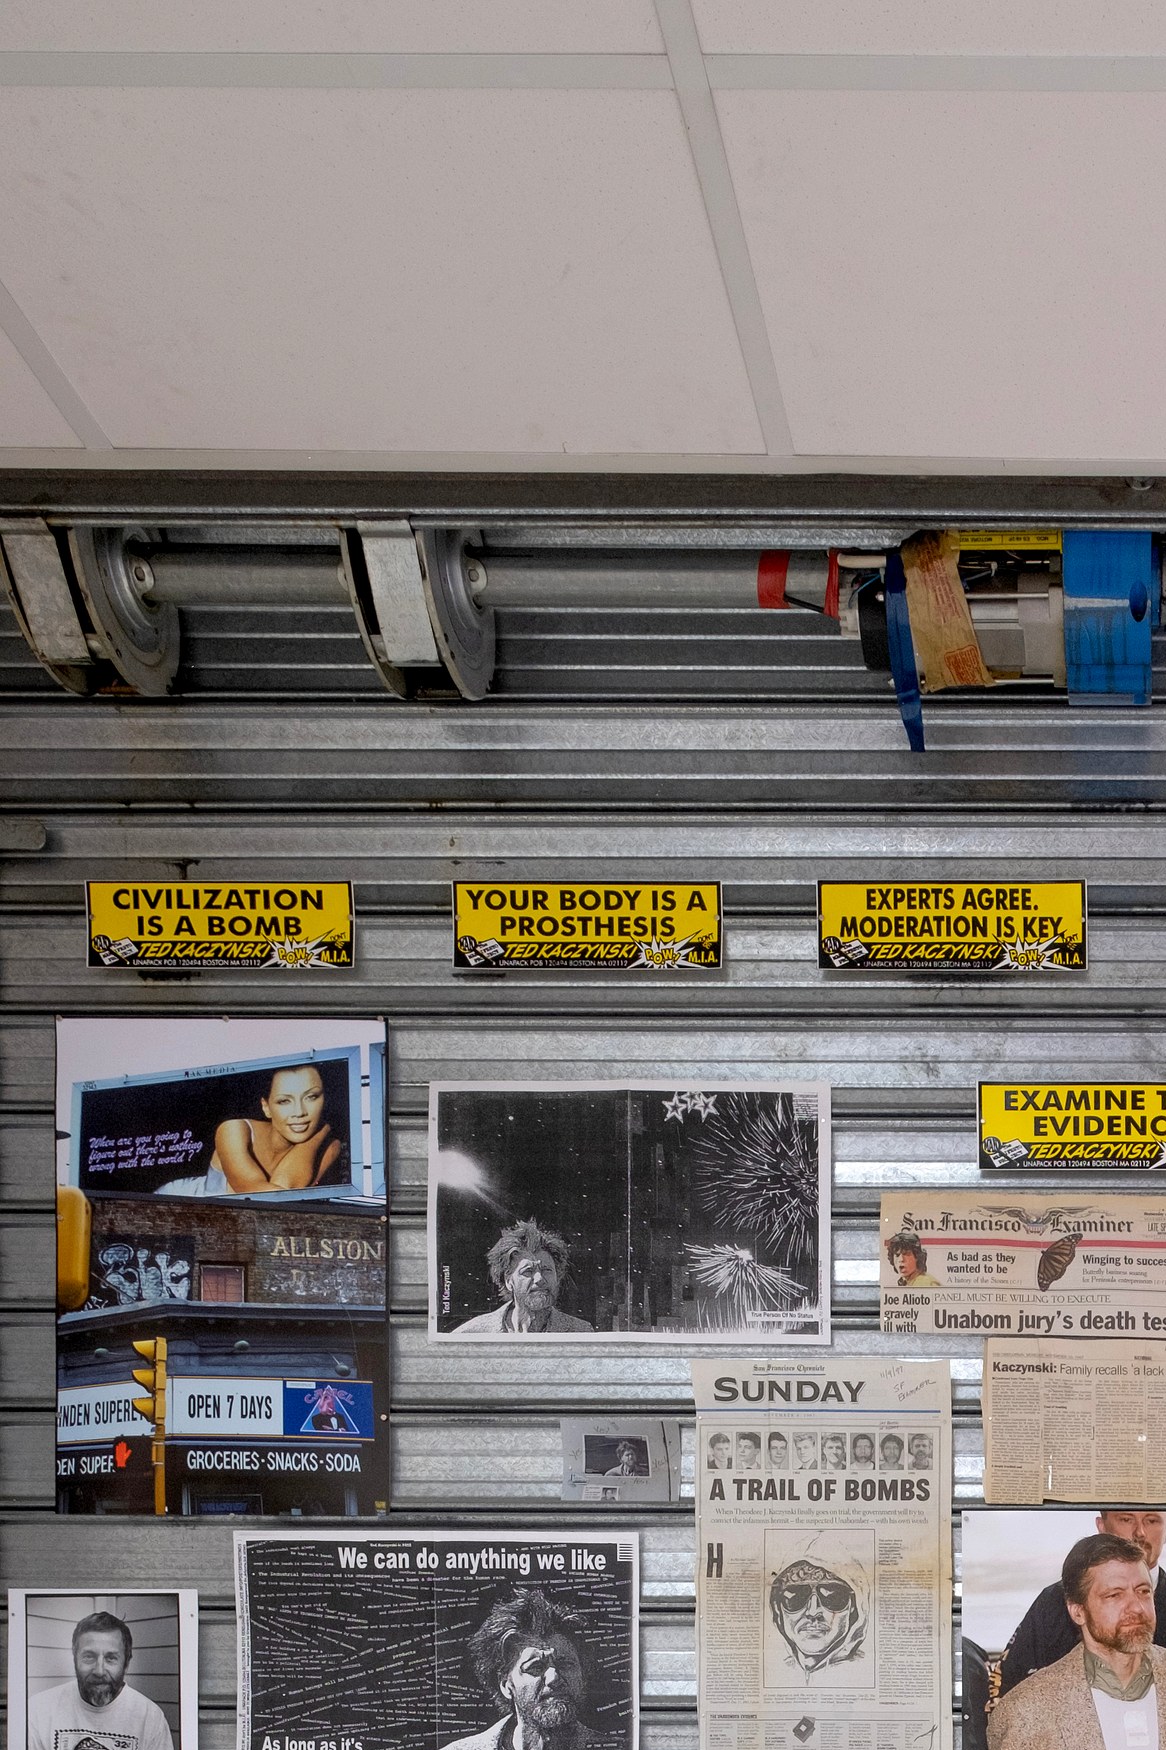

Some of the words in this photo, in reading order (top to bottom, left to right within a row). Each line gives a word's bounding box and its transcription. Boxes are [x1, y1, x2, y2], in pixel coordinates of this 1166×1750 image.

[113, 889, 323, 910] CIVILIZATION
[466, 890, 549, 910] YOUR
[560, 890, 641, 910] BODY
[652, 890, 676, 911] IS
[687, 891, 707, 911] A
[867, 888, 955, 910] EXPERTS
[962, 888, 1038, 910] AGREE.
[138, 916, 163, 936] IS
[174, 916, 196, 935] A
[208, 916, 301, 938] BOMB
[501, 916, 675, 939] PROSTHESIS
[840, 916, 987, 937] MODERATION
[997, 916, 1015, 938] IS
[1005, 1090, 1145, 1111] EXAMINE
[1061, 1144, 1159, 1159] KACZYNSKI
[1083, 1255, 1121, 1266] Winging
[1124, 1256, 1133, 1265] to
[935, 1309, 1011, 1328] Unabom
[1018, 1310, 1073, 1333] jury's
[1080, 1310, 1135, 1330] death
[714, 1377, 864, 1402] SUNDAY
[188, 1394, 220, 1418] OPEN
[227, 1395, 234, 1418] 7
[241, 1396, 272, 1419] DAYS
[710, 1479, 725, 1500] A
[733, 1479, 800, 1500] TRAIL
[808, 1479, 836, 1501] OF
[845, 1479, 930, 1501] BOMBS
[338, 1547, 367, 1569] We
[374, 1552, 409, 1569] can
[416, 1548, 439, 1569] do
[446, 1549, 530, 1575] anything
[537, 1554, 564, 1570] we
[571, 1549, 606, 1570] like
